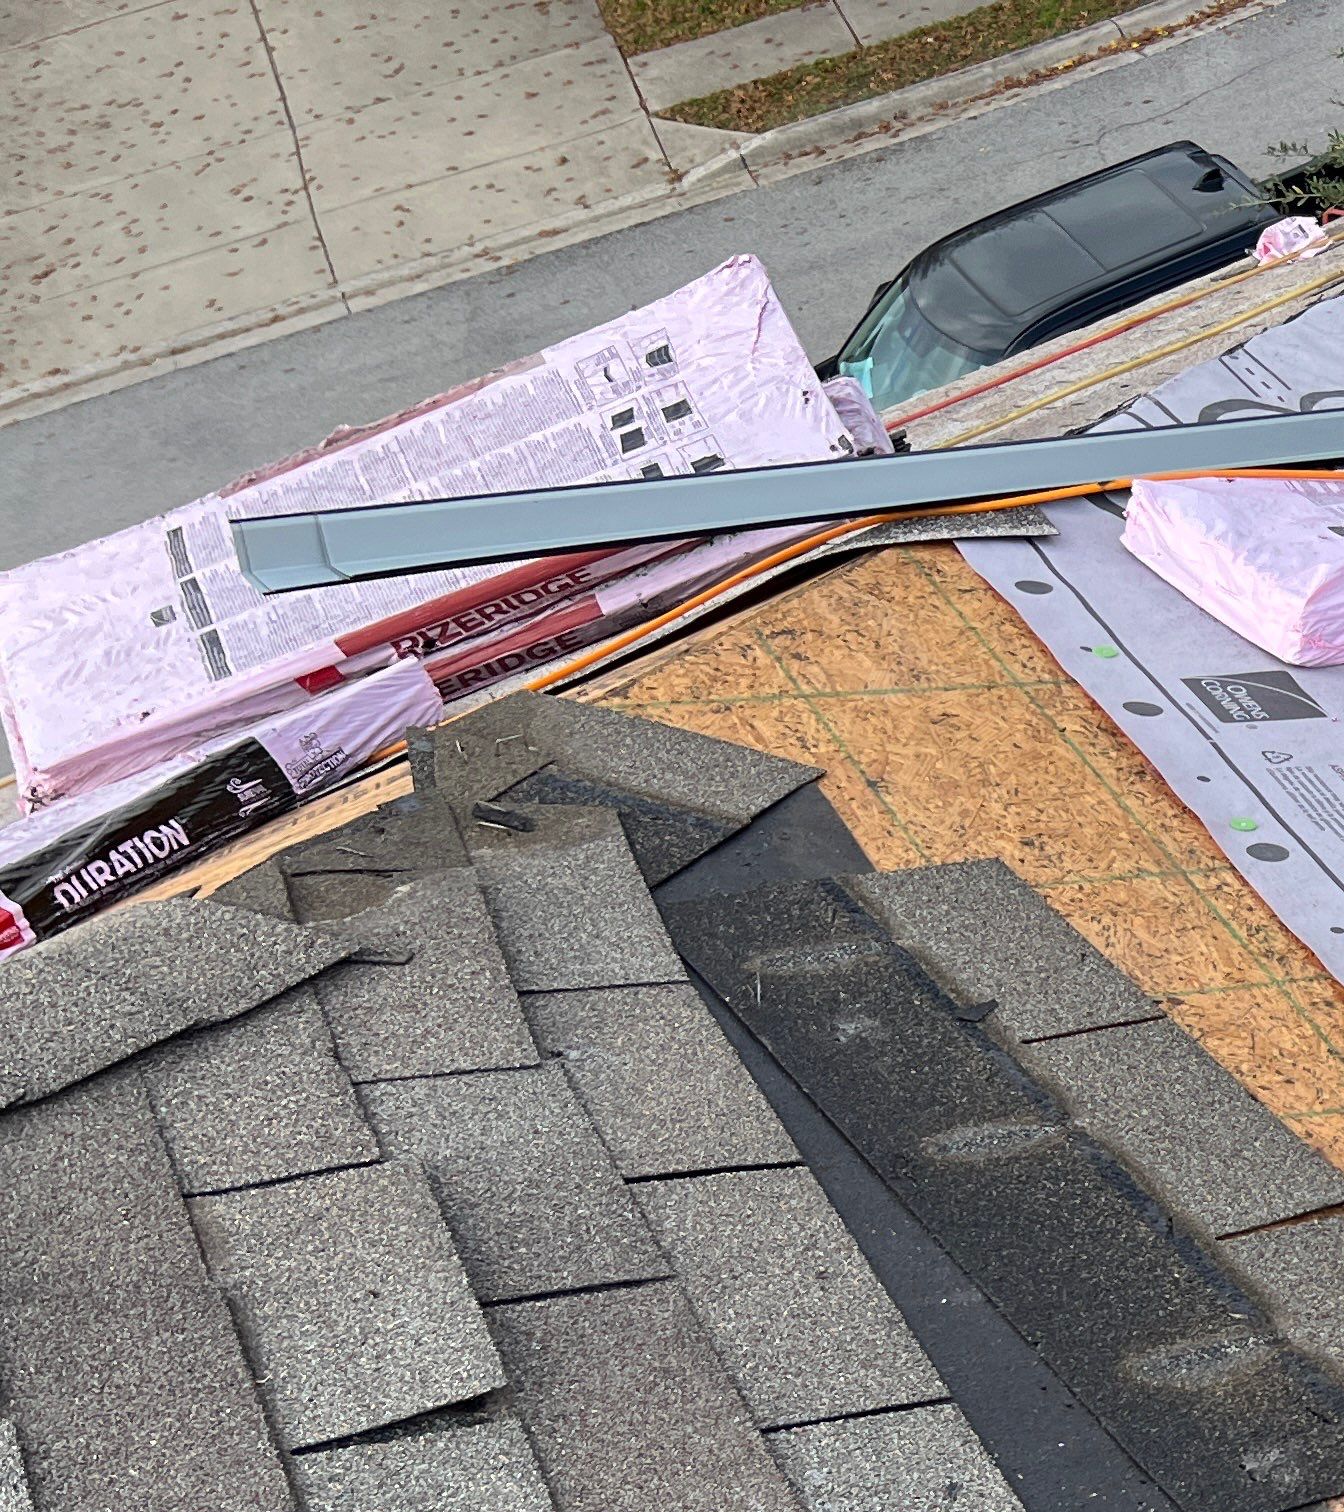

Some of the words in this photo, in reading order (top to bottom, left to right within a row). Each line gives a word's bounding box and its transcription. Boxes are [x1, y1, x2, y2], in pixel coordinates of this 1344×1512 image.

[434, 629, 587, 699] ERIDGE
[1200, 679, 1251, 721] CORNING
[1226, 684, 1270, 720] OWENS
